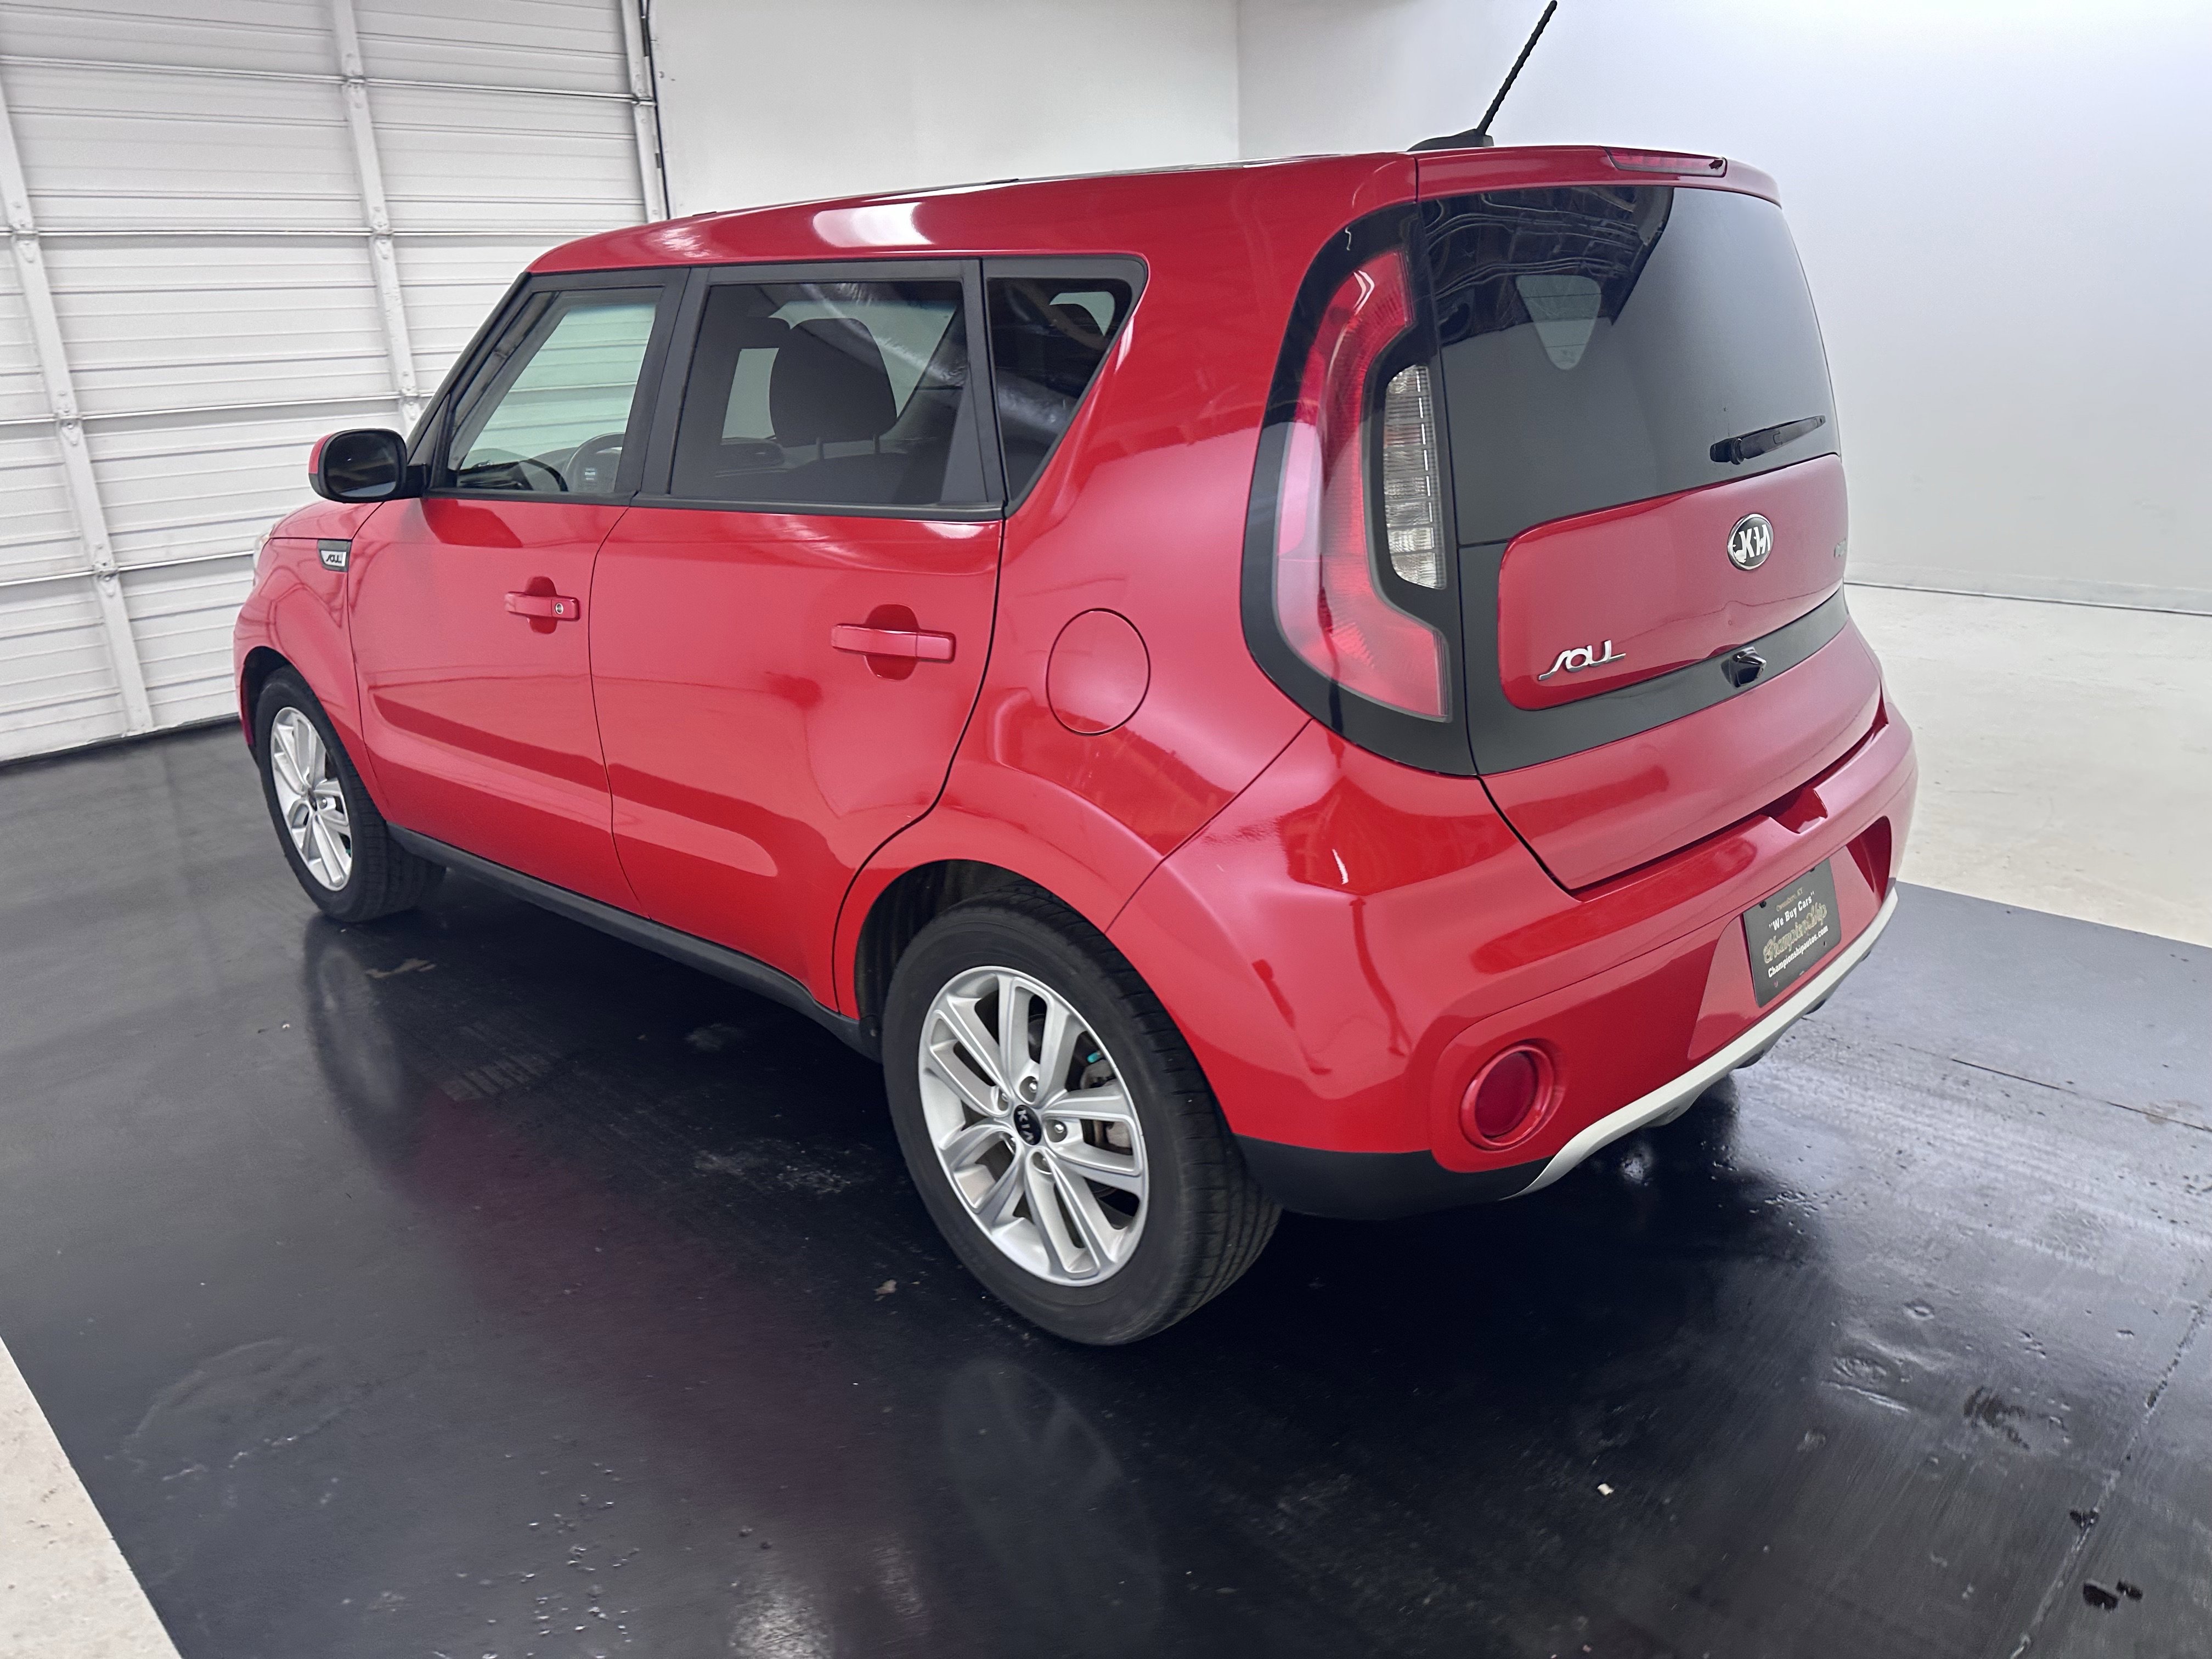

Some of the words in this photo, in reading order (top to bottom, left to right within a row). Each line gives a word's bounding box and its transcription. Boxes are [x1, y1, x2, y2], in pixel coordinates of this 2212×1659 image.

[1738, 524, 1771, 558] KIA
[1538, 639, 1626, 681] SOUL
[1785, 907, 1797, 922] Buy
[1768, 925, 1829, 978] Championshipautos.com
[1017, 1110, 1034, 1142] KIA
